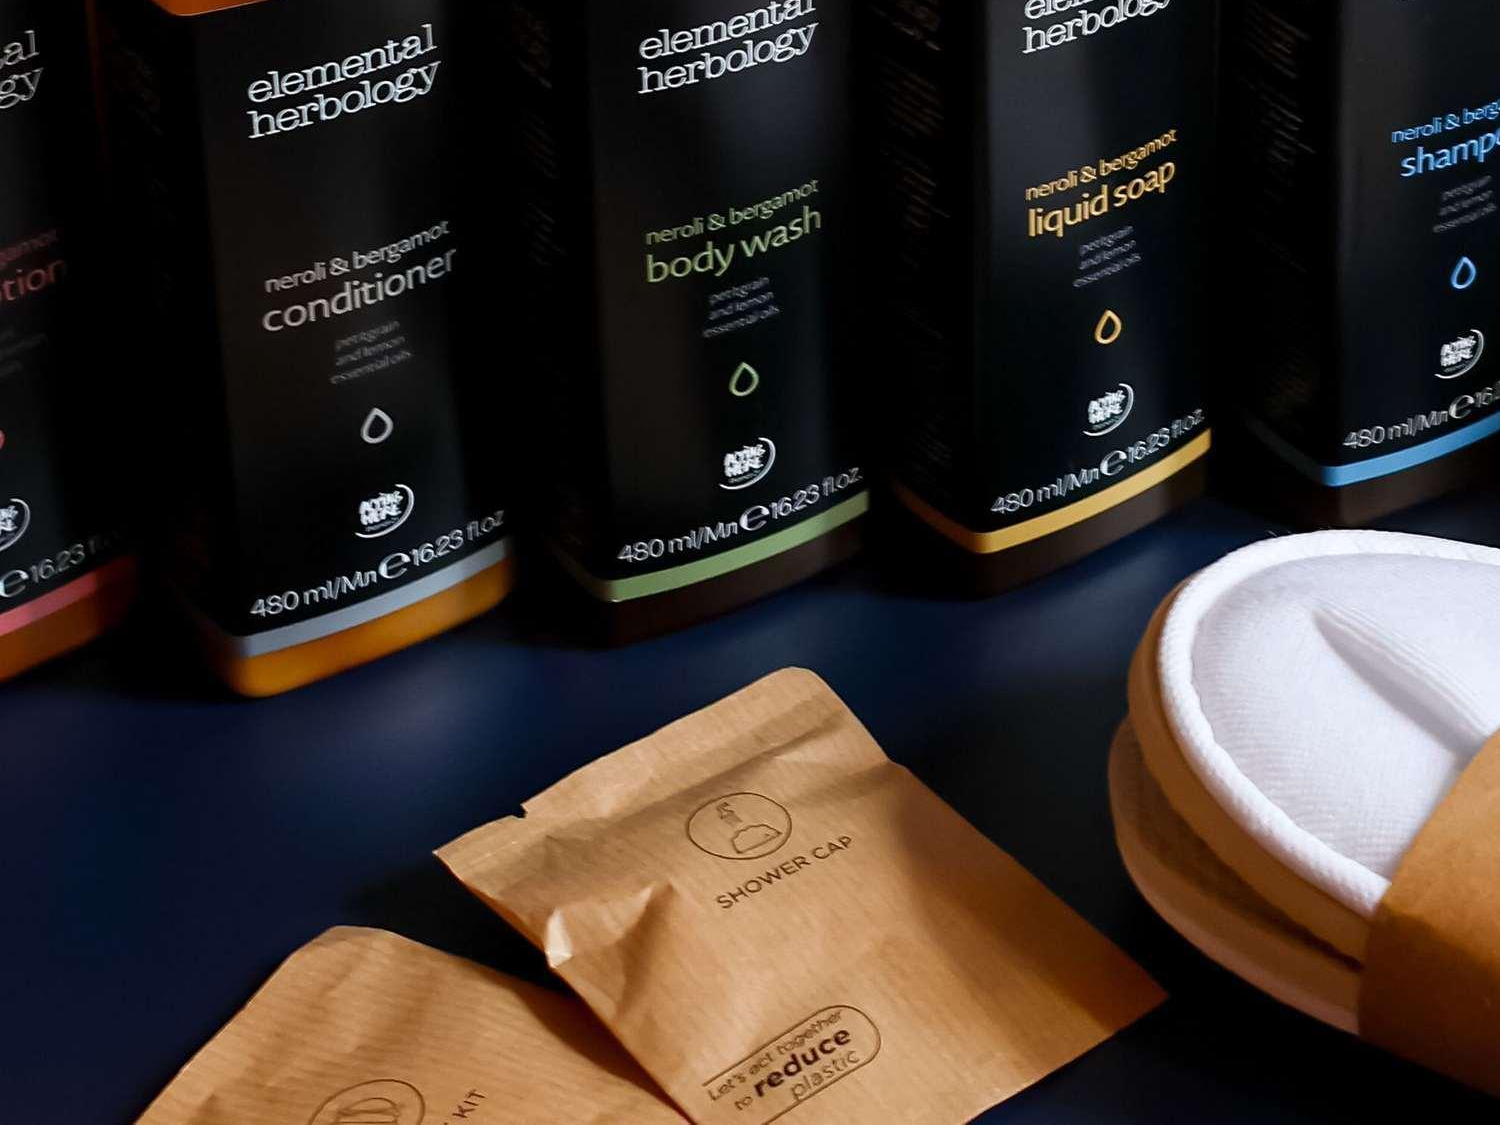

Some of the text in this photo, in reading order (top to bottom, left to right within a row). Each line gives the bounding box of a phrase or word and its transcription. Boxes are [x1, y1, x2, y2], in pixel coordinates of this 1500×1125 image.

[248, 23, 437, 103] elemental
[637, 22, 819, 94] herbology
[246, 60, 442, 139] herbology
[1391, 117, 1442, 144] neroli
[1444, 113, 1461, 130] &
[1025, 129, 1178, 201] neroli & bergamot
[1027, 161, 1176, 237] liquid soap
[645, 179, 819, 245] neroli & bergamot
[646, 205, 822, 283] body wash
[263, 248, 457, 332] conditioner
[264, 220, 450, 293] neroli & bergamot
[1342, 426, 1385, 449] 480
[990, 488, 1034, 514] 480
[617, 538, 665, 562] 480
[250, 590, 300, 617] 480
[716, 835, 852, 909] SHOWER CAP
[707, 1010, 843, 1101] Let's act together
[734, 1029, 852, 1111] to reduce
[790, 1050, 860, 1102] plastic
[452, 1088, 487, 1119] KIT
